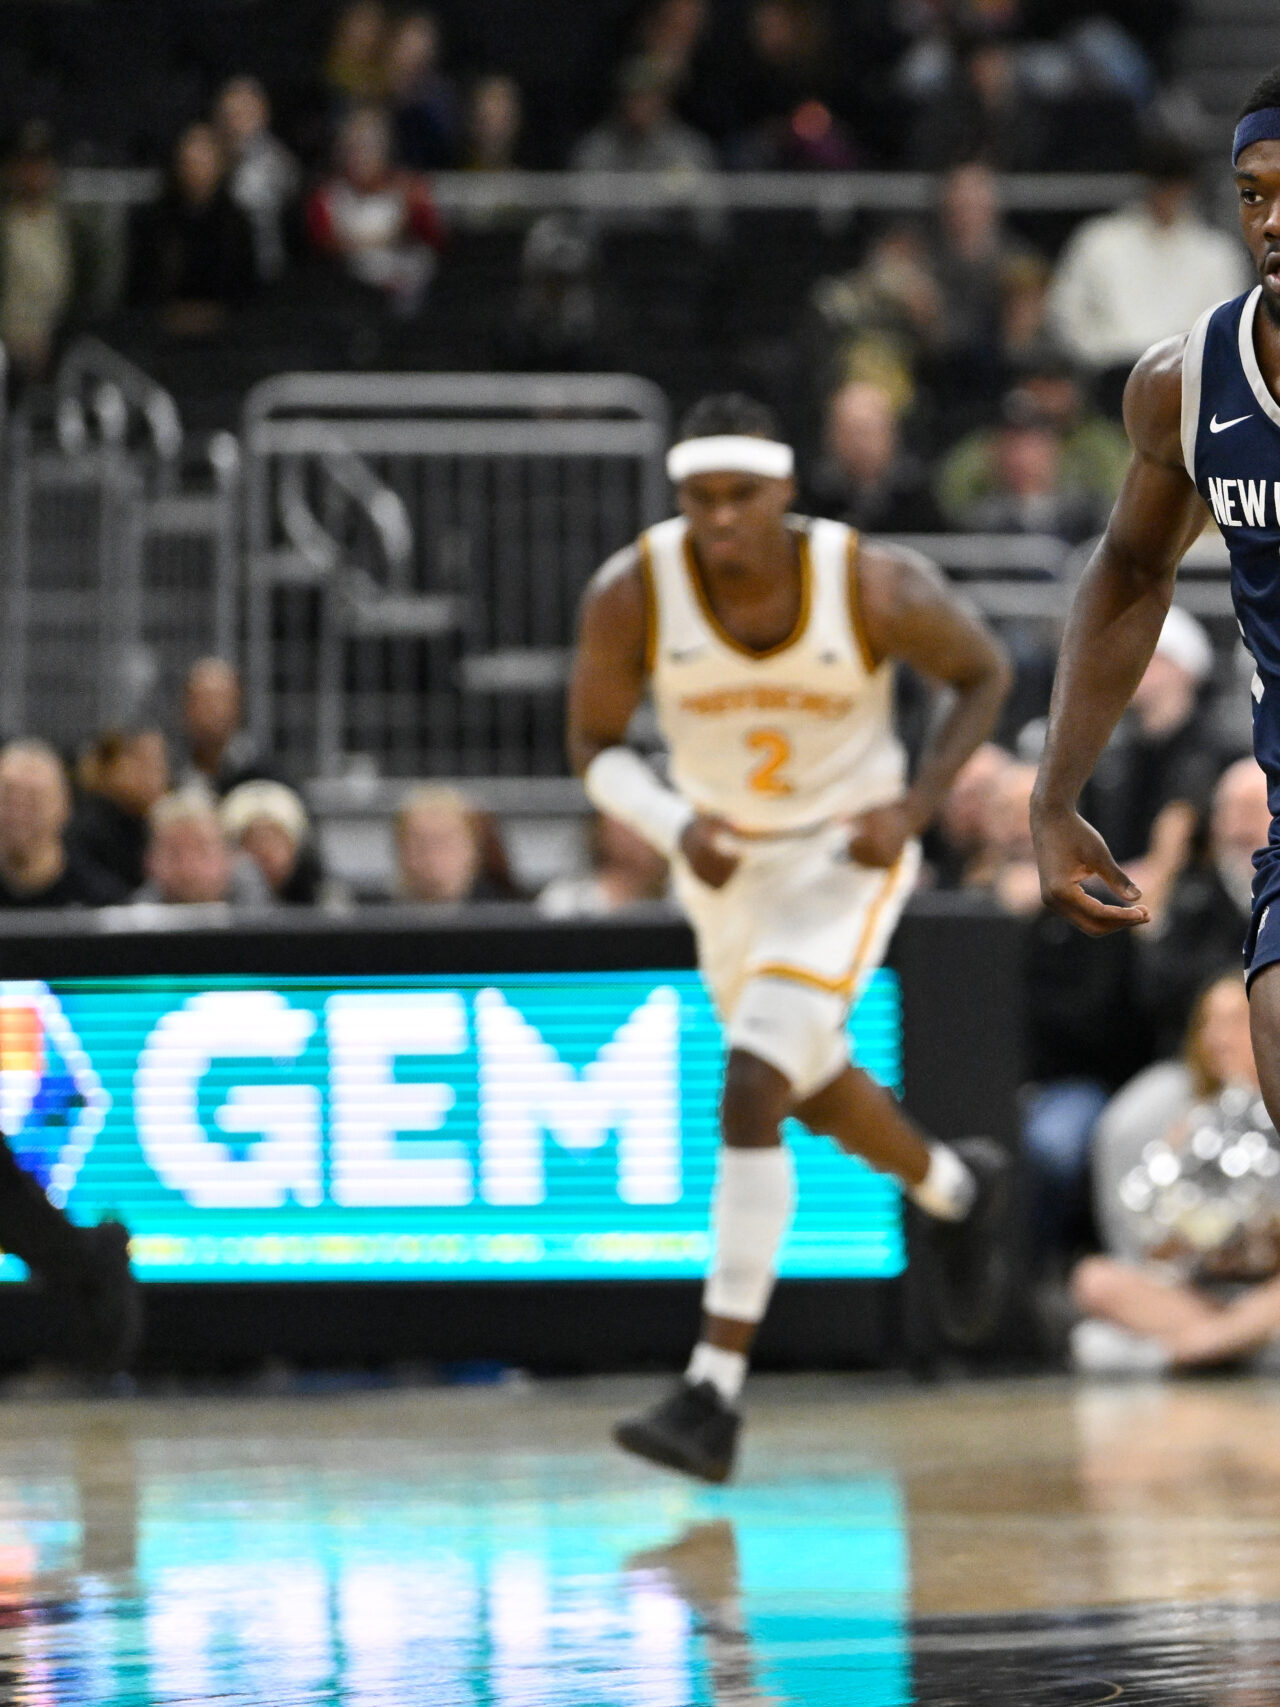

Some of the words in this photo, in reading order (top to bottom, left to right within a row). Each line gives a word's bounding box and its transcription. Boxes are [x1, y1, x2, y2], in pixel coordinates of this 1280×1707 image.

[1208, 477, 1266, 527] NEW
[746, 728, 793, 796] 2
[134, 987, 682, 1208] GEM
